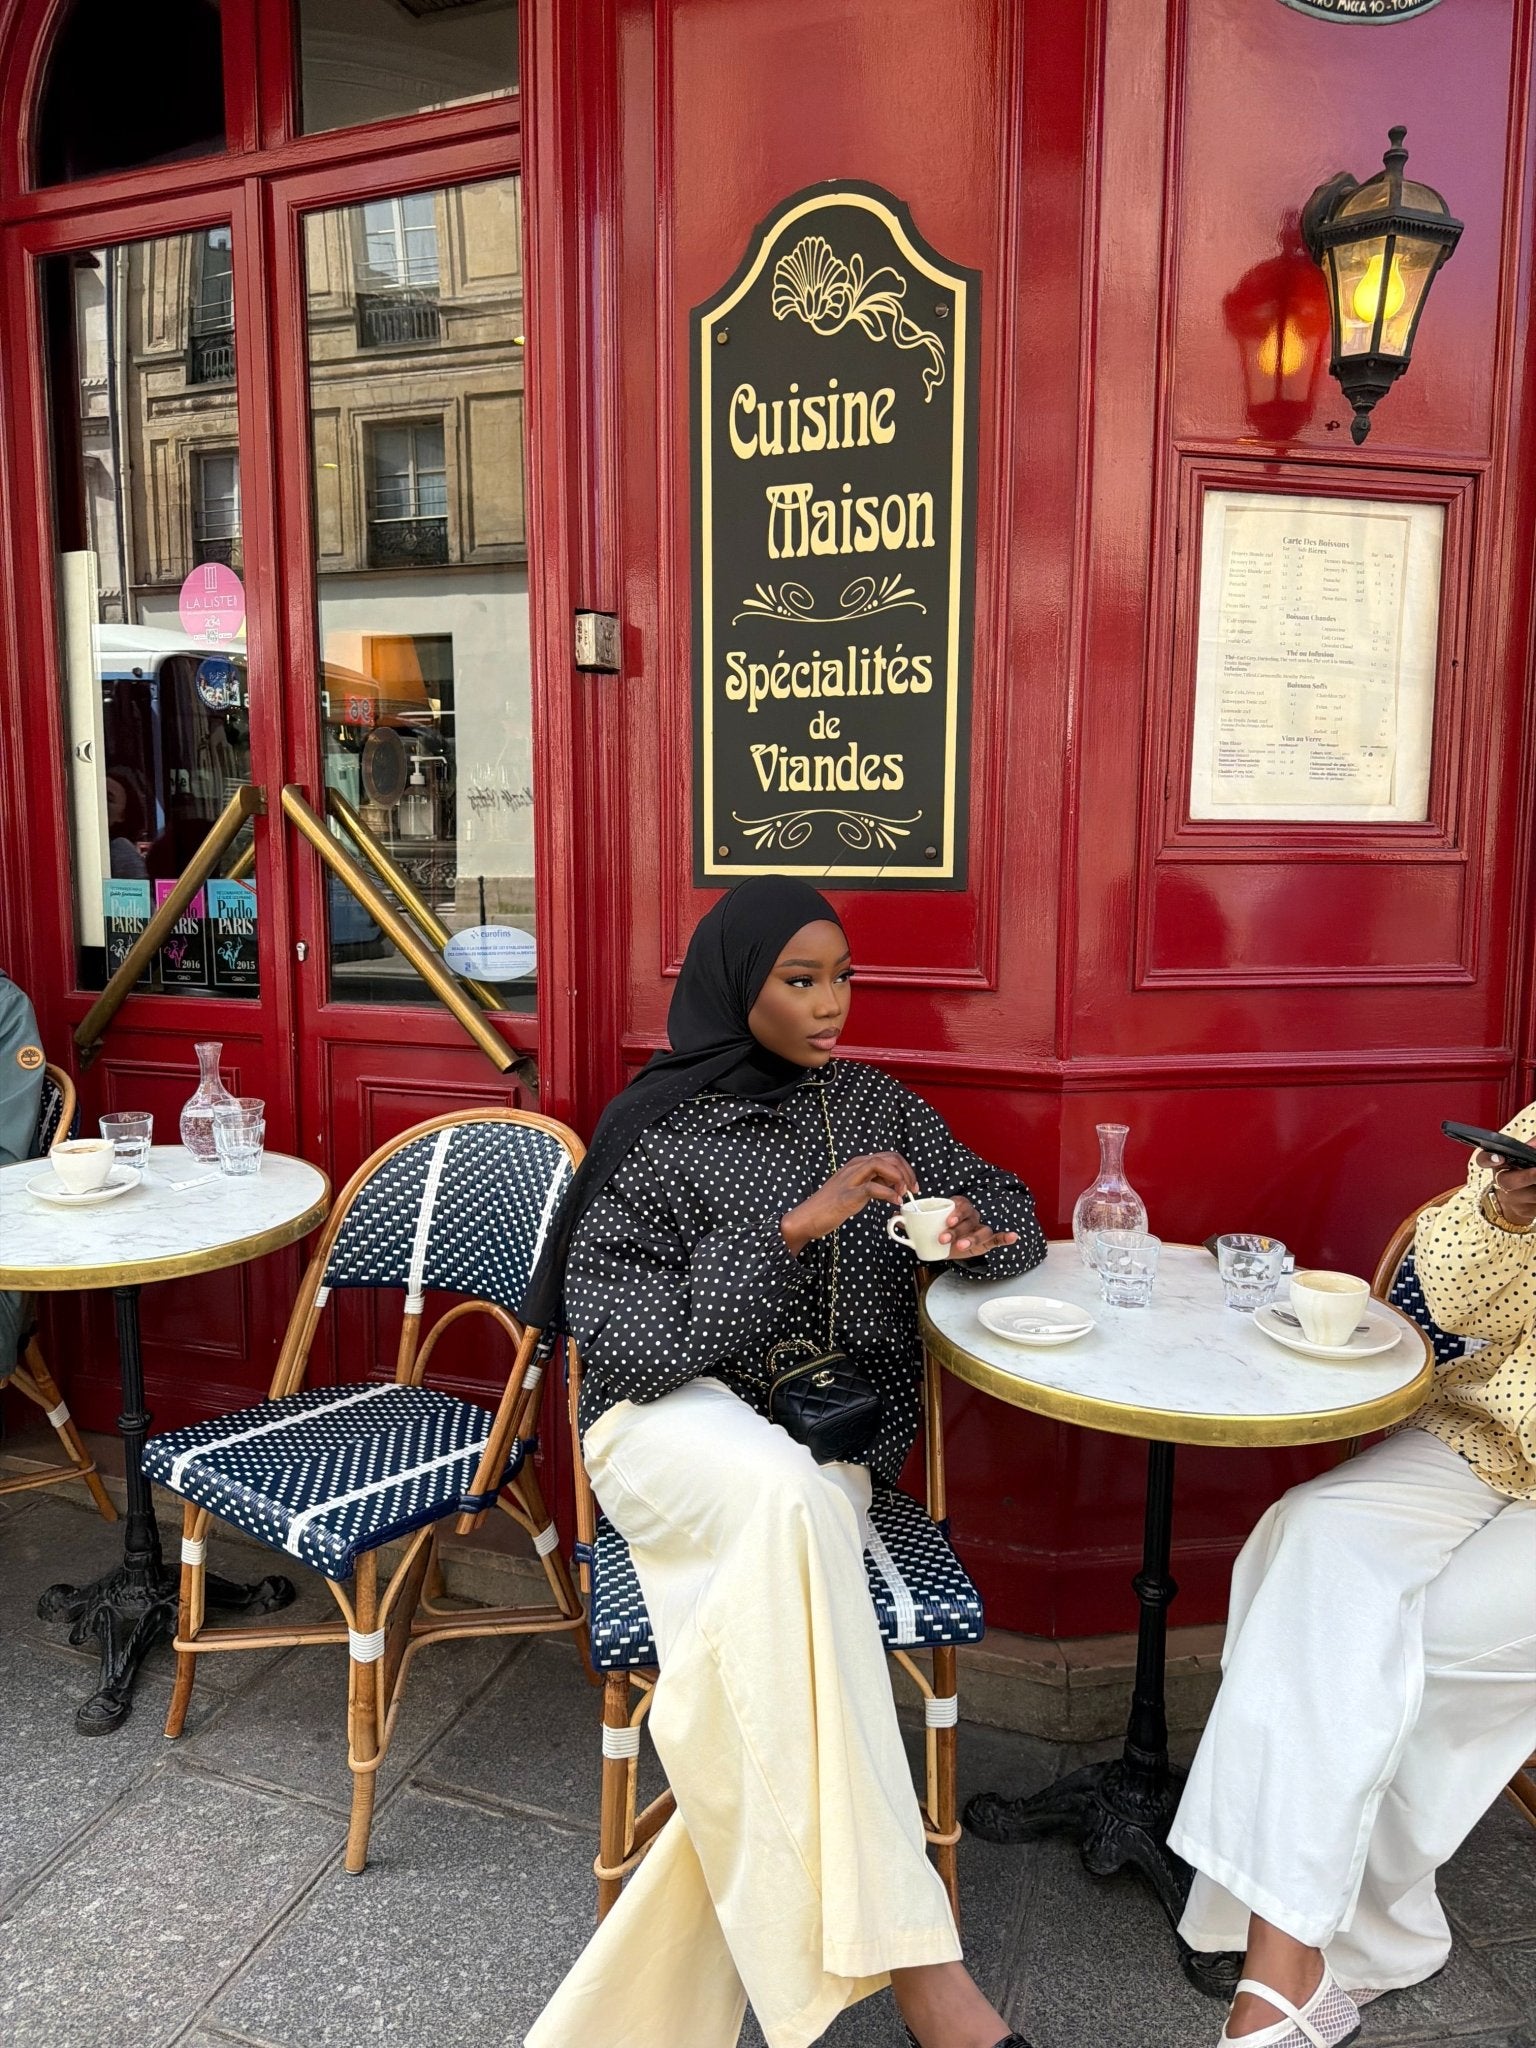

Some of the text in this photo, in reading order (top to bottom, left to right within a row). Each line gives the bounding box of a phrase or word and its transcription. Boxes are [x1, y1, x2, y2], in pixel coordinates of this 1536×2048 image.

[729, 378, 895, 459] Cuisine
[766, 483, 935, 559] Maison
[1282, 536, 1302, 545] Carte
[1318, 539, 1350, 548] Boissons
[186, 599, 200, 609] LA
[726, 644, 933, 715] Spécialités
[809, 709, 840, 739] de
[750, 742, 904, 792] Viandes
[217, 899, 252, 919] Pudlo
[111, 916, 144, 933] PARIS
[170, 917, 199, 935] ARIS
[218, 917, 254, 935] PARIS
[480, 929, 511, 938] eurofins
[182, 960, 200, 969] 2016
[236, 961, 256, 969] 2015
